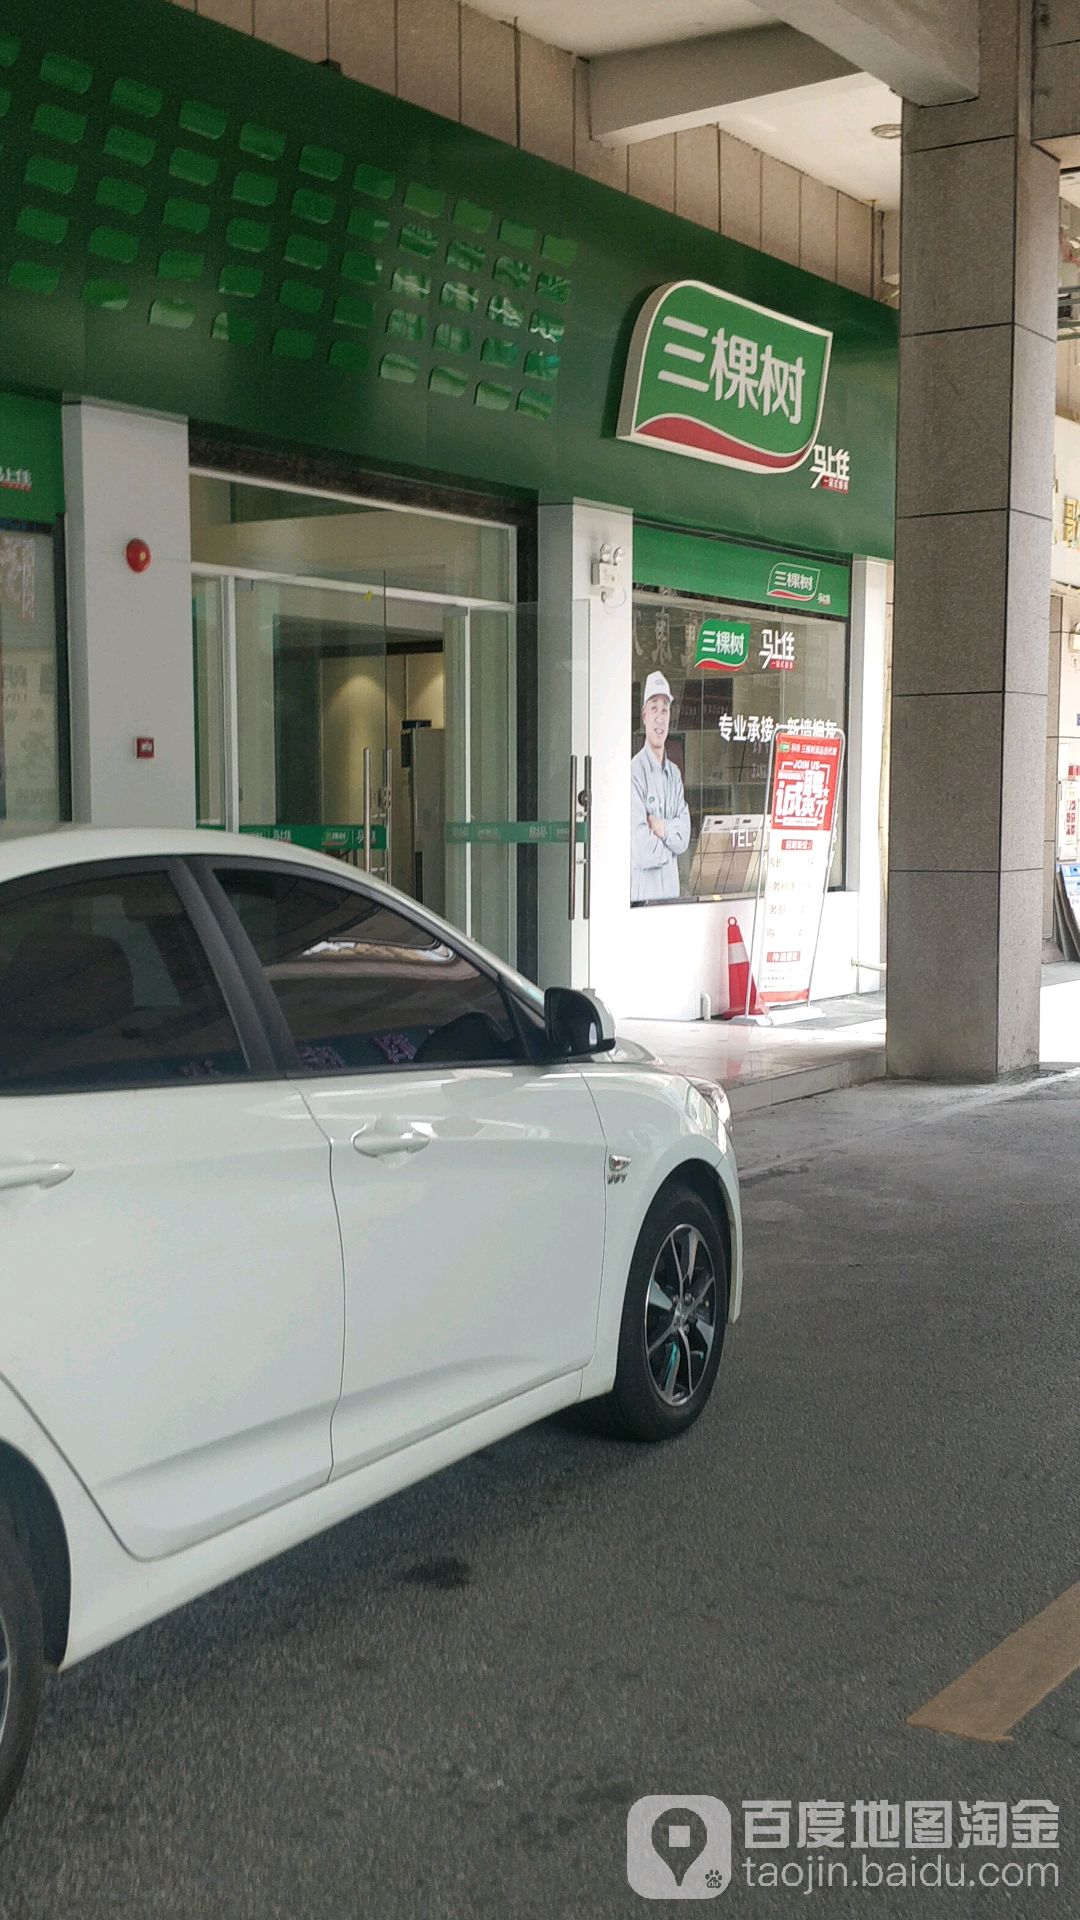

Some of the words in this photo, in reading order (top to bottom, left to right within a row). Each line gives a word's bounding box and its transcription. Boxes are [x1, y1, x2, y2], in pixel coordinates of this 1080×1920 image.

[657, 315, 806, 425] 三棵树
[773, 570, 814, 592] 三棵树
[701, 629, 745, 657] 三棵树
[758, 629, 795, 669] 马上住
